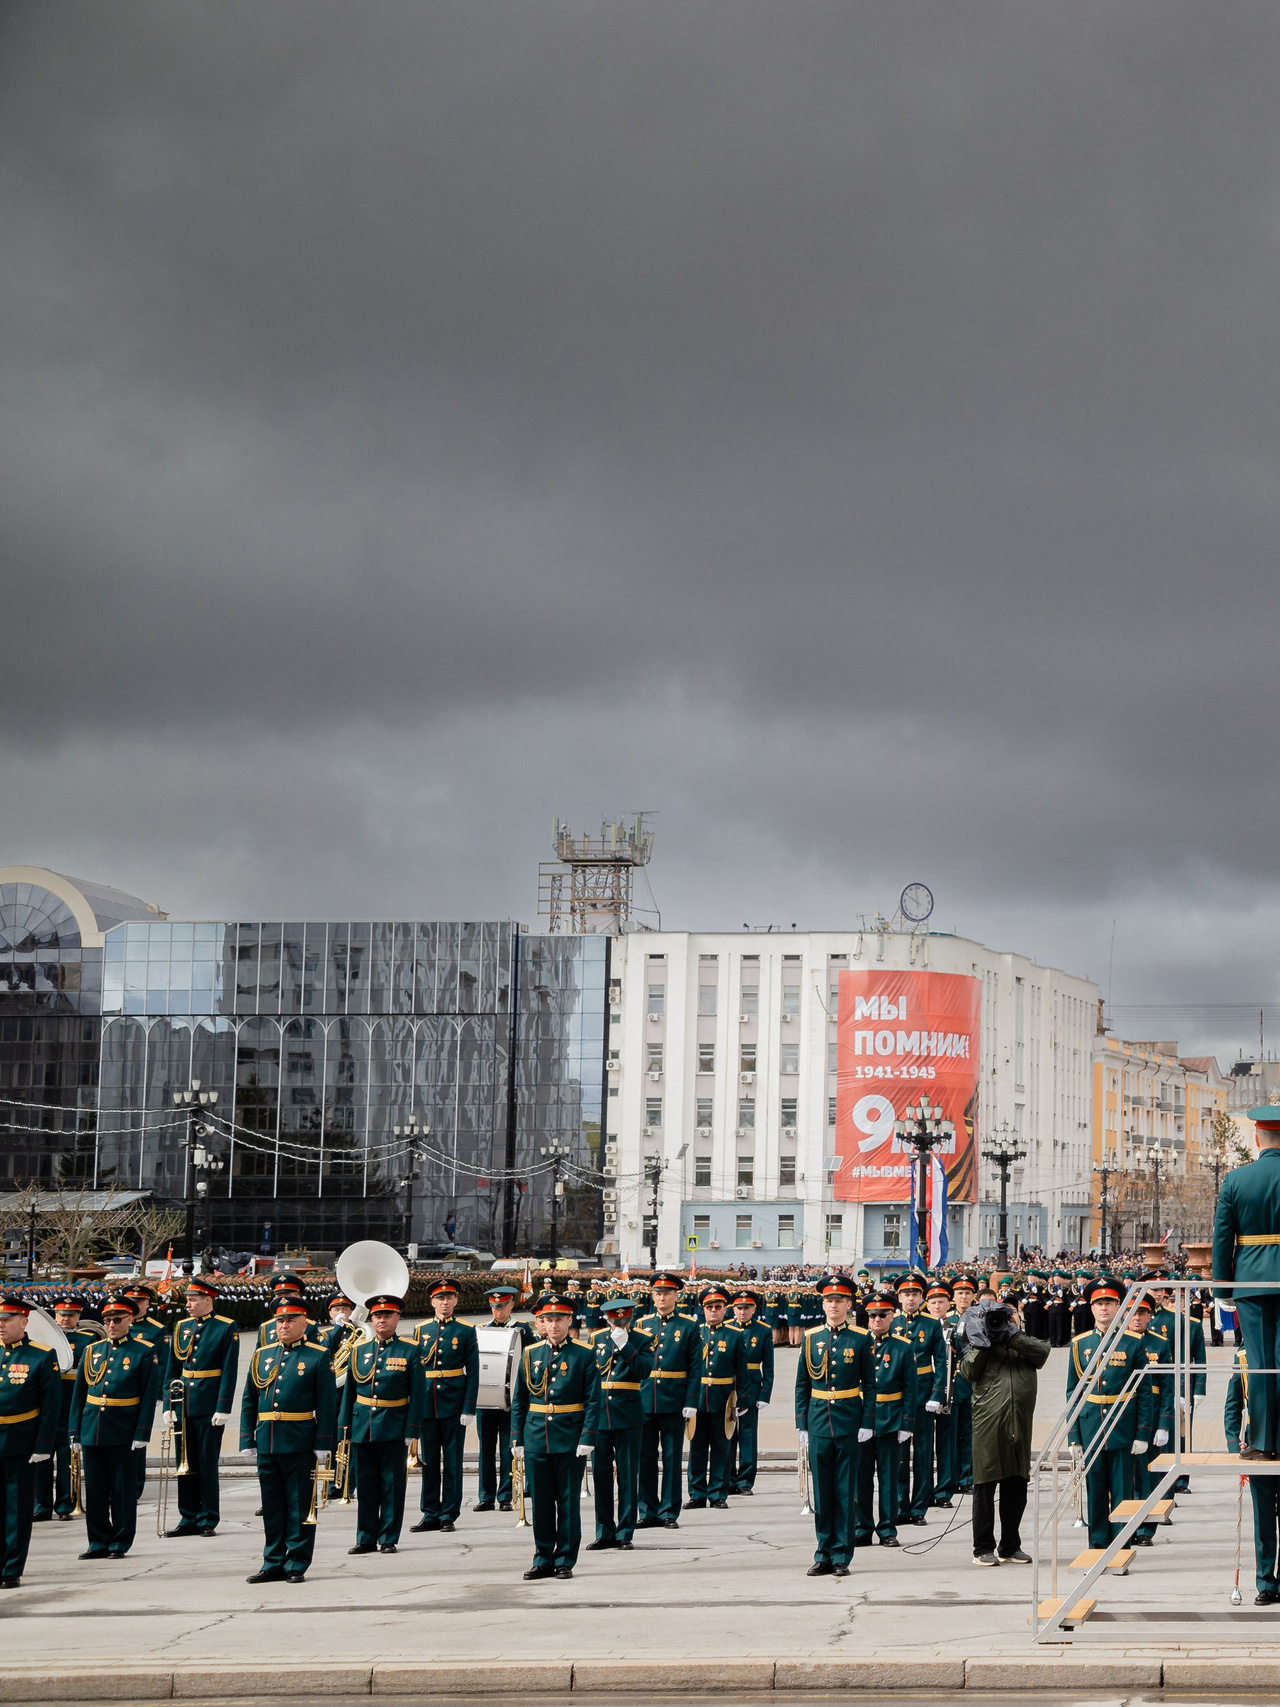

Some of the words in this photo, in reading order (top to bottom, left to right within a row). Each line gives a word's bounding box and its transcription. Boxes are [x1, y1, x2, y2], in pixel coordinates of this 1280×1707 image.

[854, 995, 907, 1021] МЫ
[854, 1029, 970, 1059] ПОМНИМ!
[855, 1065, 937, 1079] 1941-1945
[852, 1094, 896, 1153] 9
